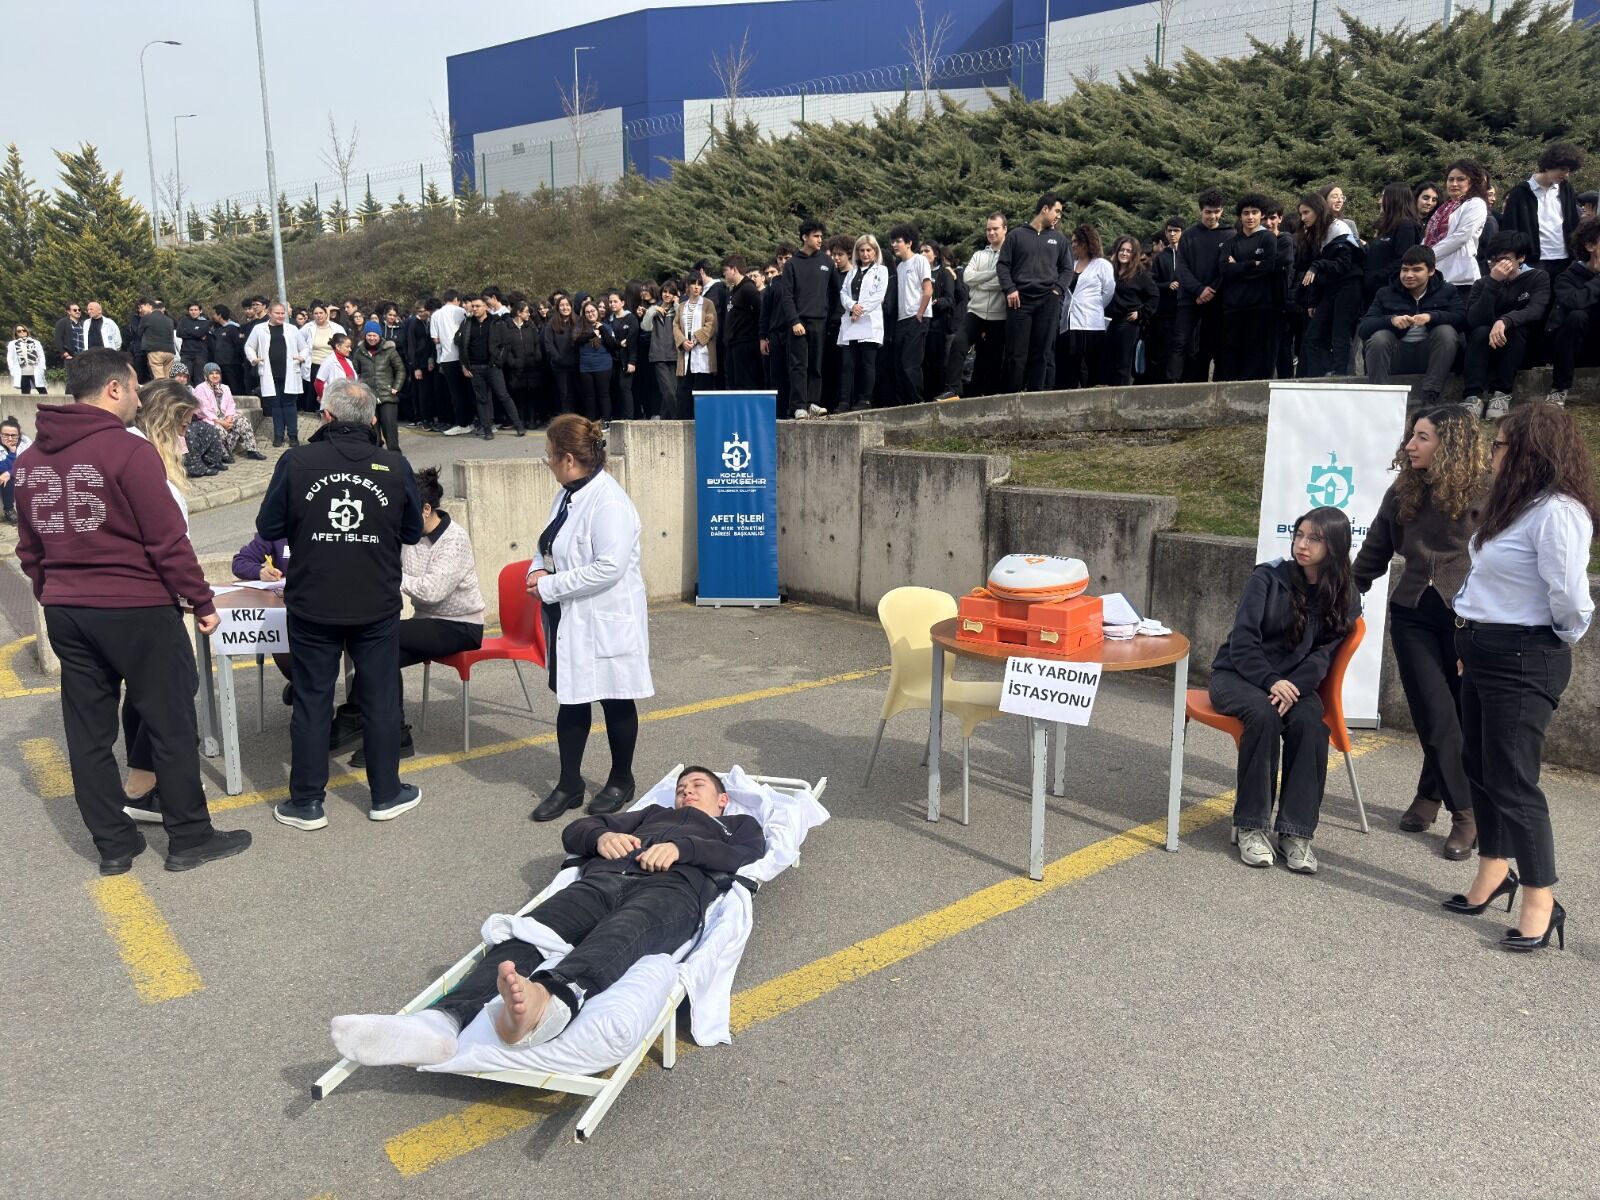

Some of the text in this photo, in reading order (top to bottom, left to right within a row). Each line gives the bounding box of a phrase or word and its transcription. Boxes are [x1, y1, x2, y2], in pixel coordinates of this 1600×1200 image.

[710, 512, 765, 525] AFET İŞLERİ
[311, 532, 342, 542] AFET
[221, 629, 281, 645] MASASI
[1010, 659, 1099, 687] İLK YARDIM
[1007, 679, 1092, 709] İSTASYONU
